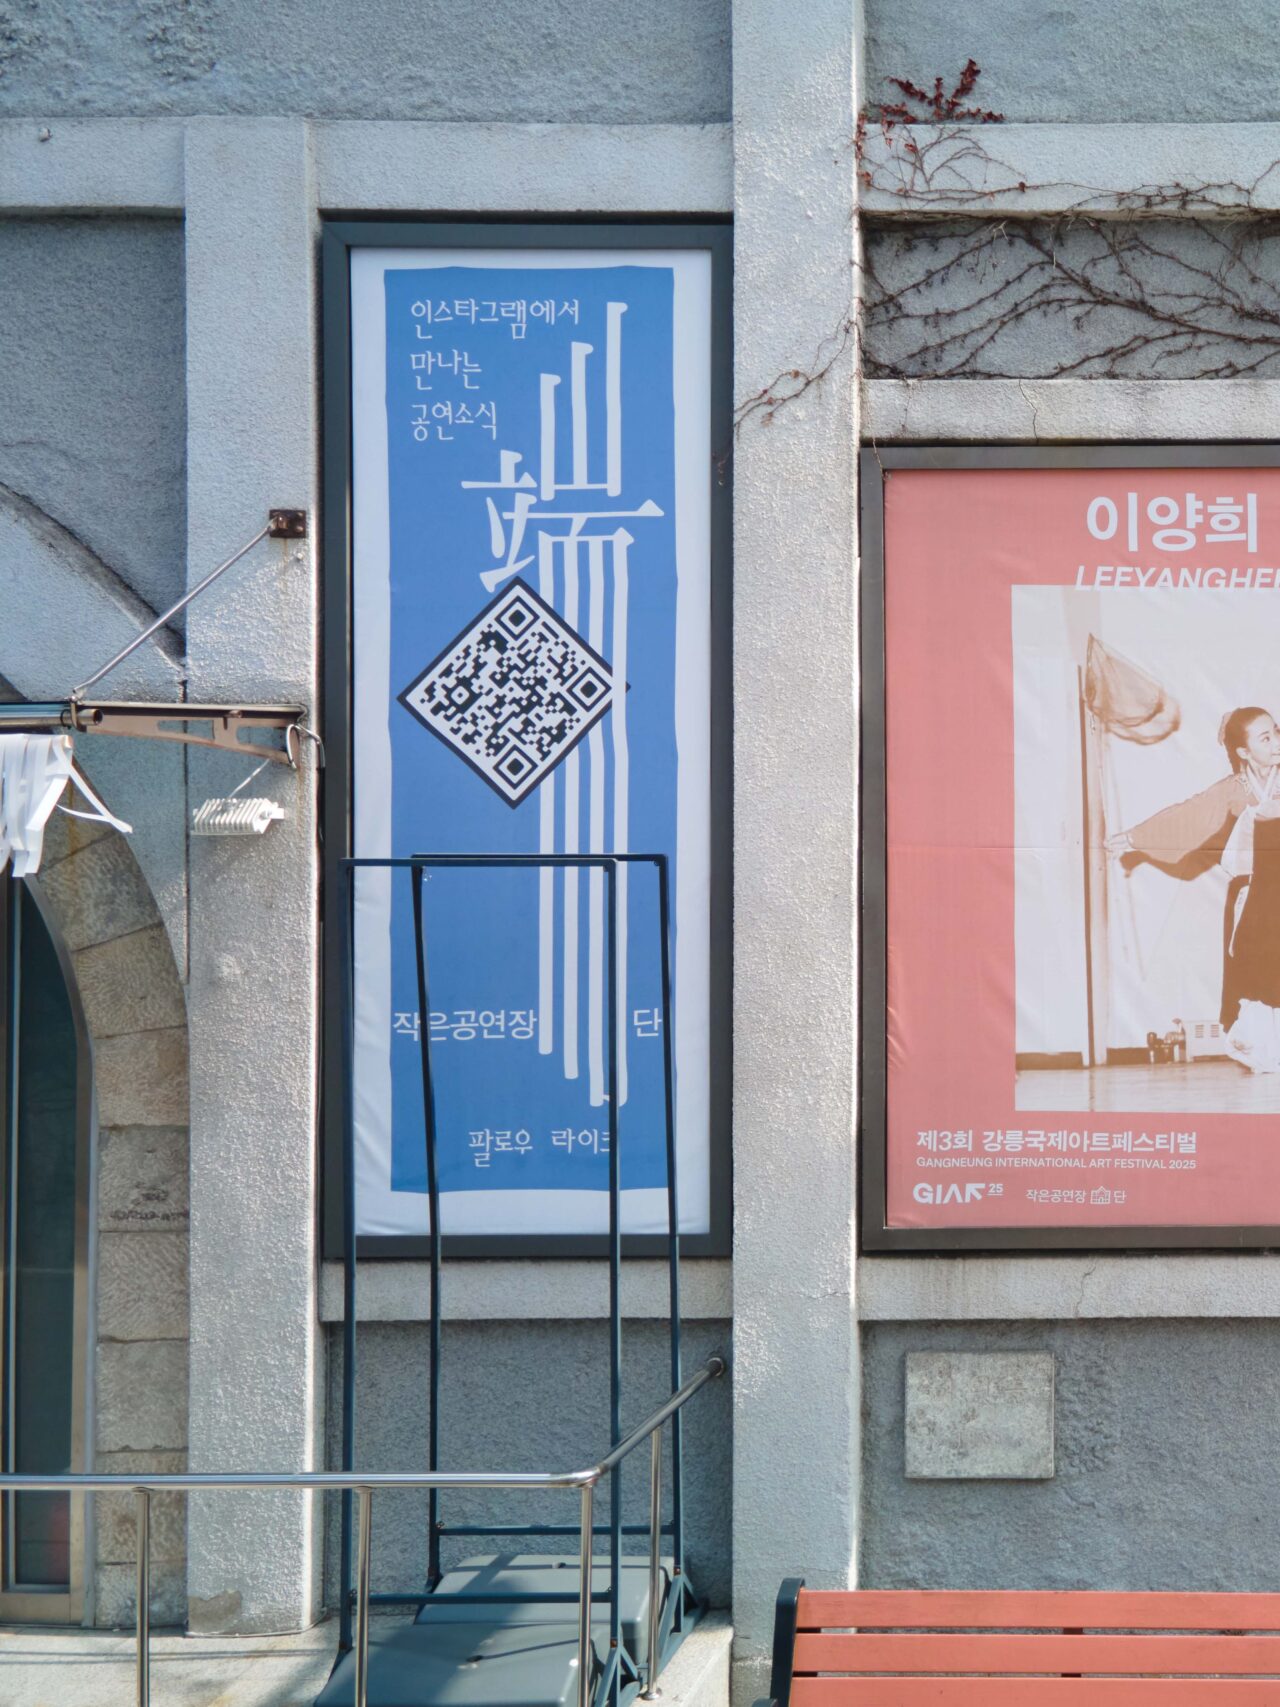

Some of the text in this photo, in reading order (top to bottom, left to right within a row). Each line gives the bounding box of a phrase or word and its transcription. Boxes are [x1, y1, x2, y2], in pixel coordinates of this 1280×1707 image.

[410, 298, 580, 340] 인스타그램에서
[410, 350, 482, 391] 만나는
[410, 400, 497, 441] 공연소식
[1086, 492, 1258, 553] 이양희
[393, 1007, 663, 1042] 작은공연장 단
[468, 1128, 534, 1168] 팔로우
[916, 1129, 1197, 1154] 제3회 강릉국제아트페스티벌
[916, 1156, 1197, 1169] GANGNEUNG INTERNATIONAL ART FESTIVAL 2025
[987, 1183, 1004, 1193] 25
[1025, 1189, 1127, 1204] 작은공연장 단
